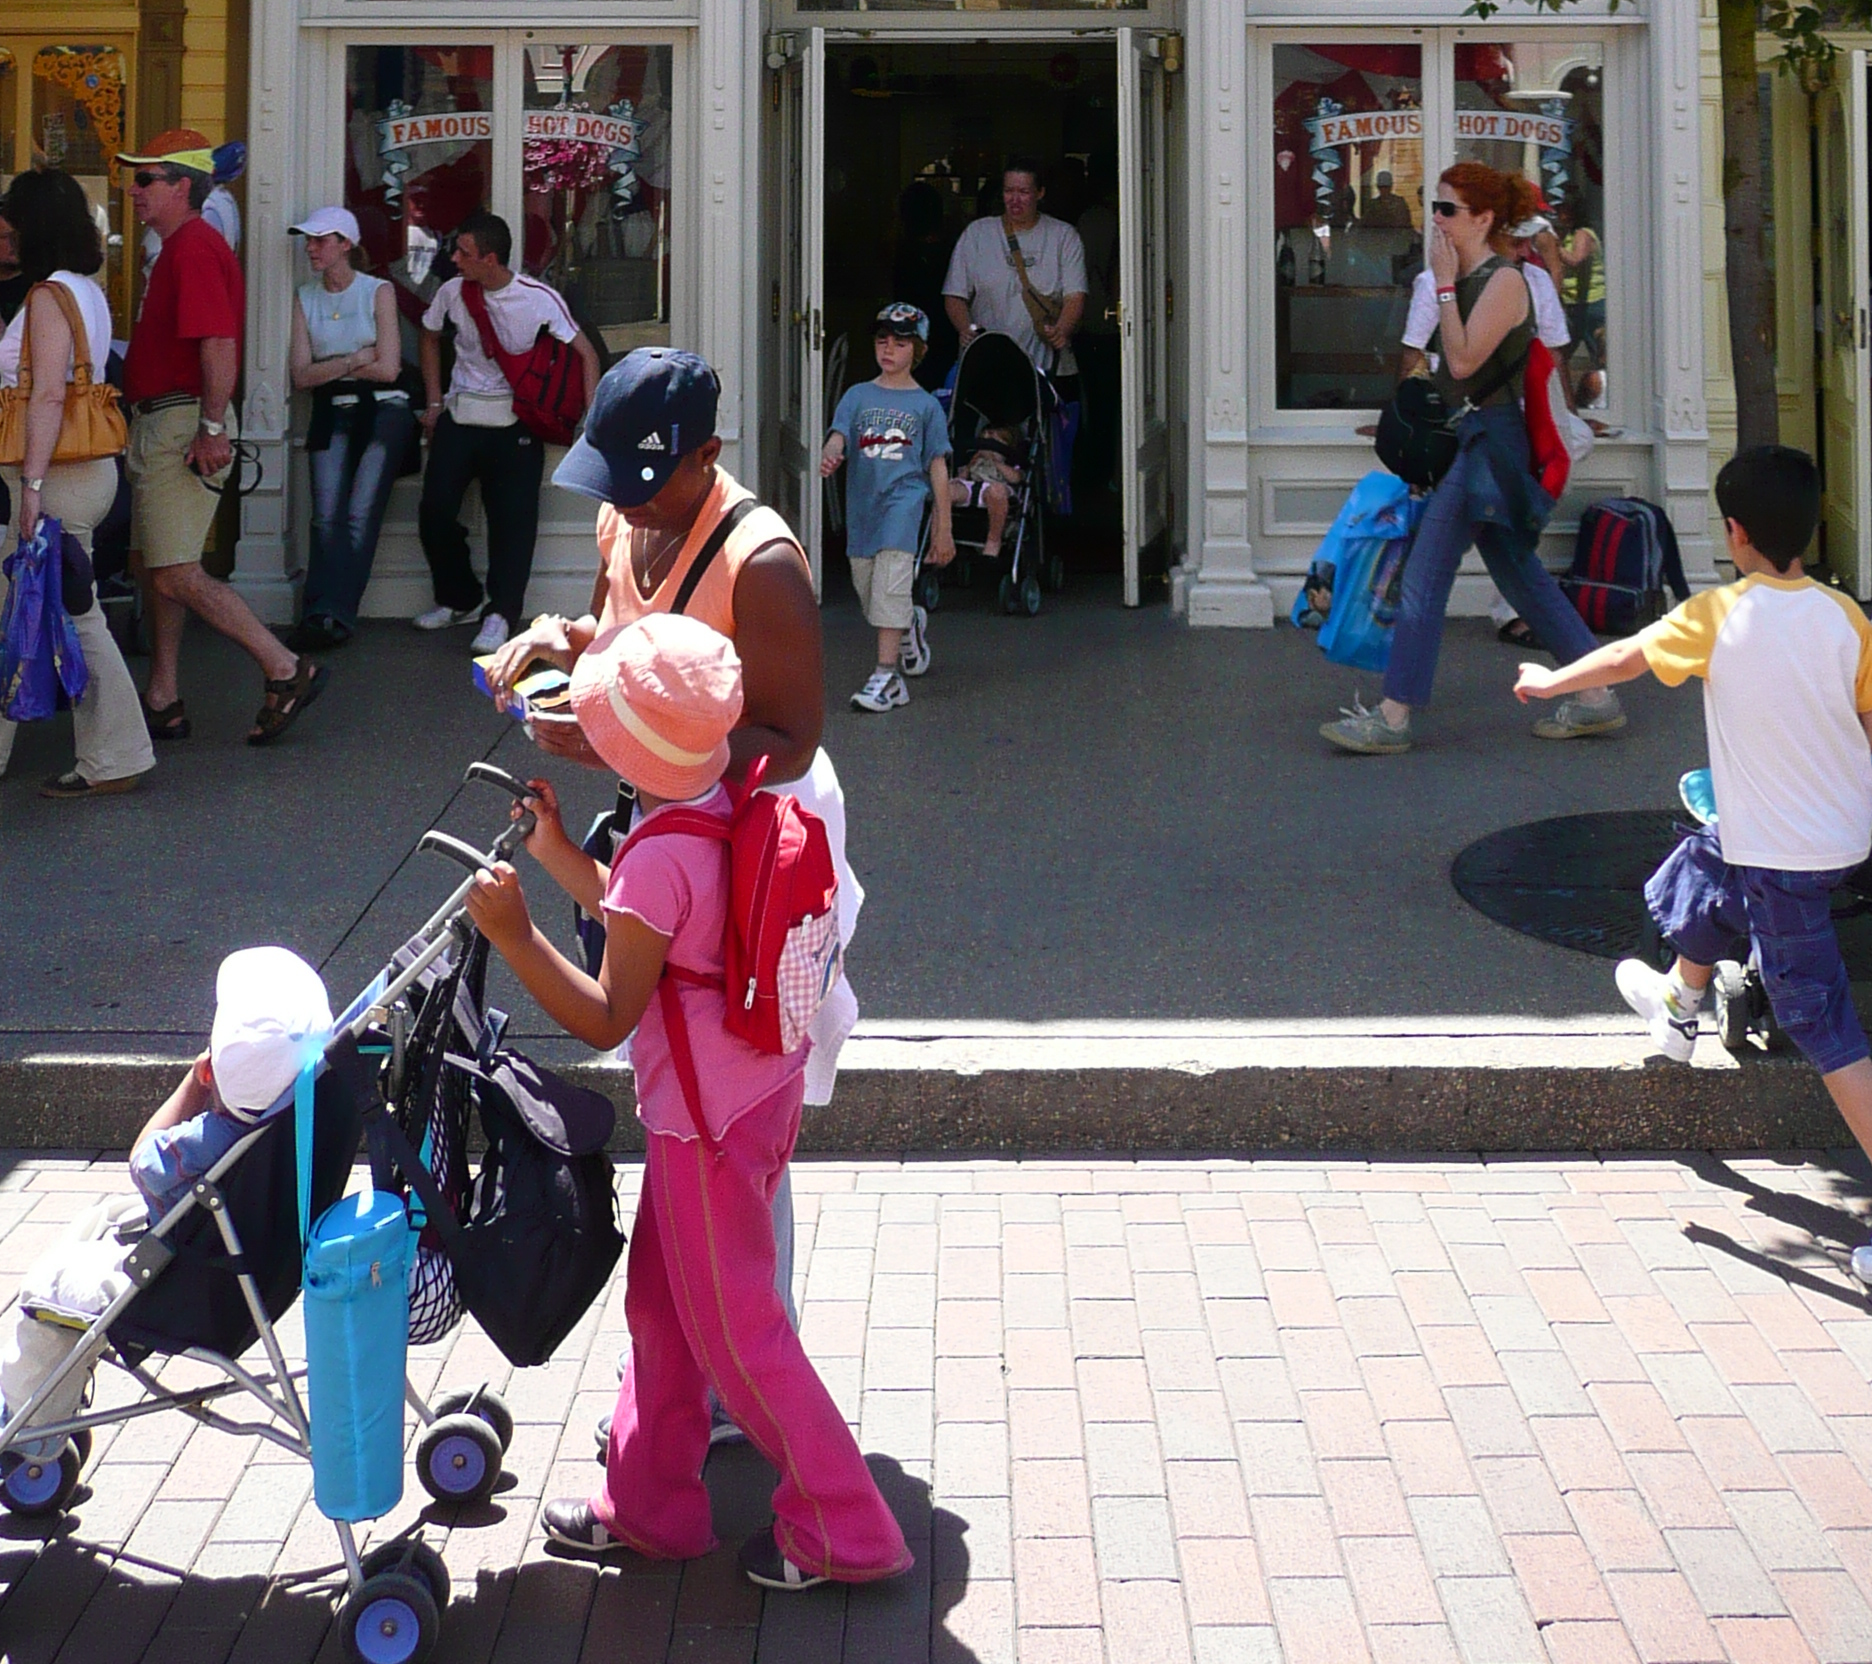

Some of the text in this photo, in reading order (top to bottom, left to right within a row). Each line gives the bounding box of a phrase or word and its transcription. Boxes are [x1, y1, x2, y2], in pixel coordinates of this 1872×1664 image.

[392, 115, 633, 146] FAMOUS HOT DOGS
[1321, 115, 1563, 144] FAMOUS HOT DOGS
